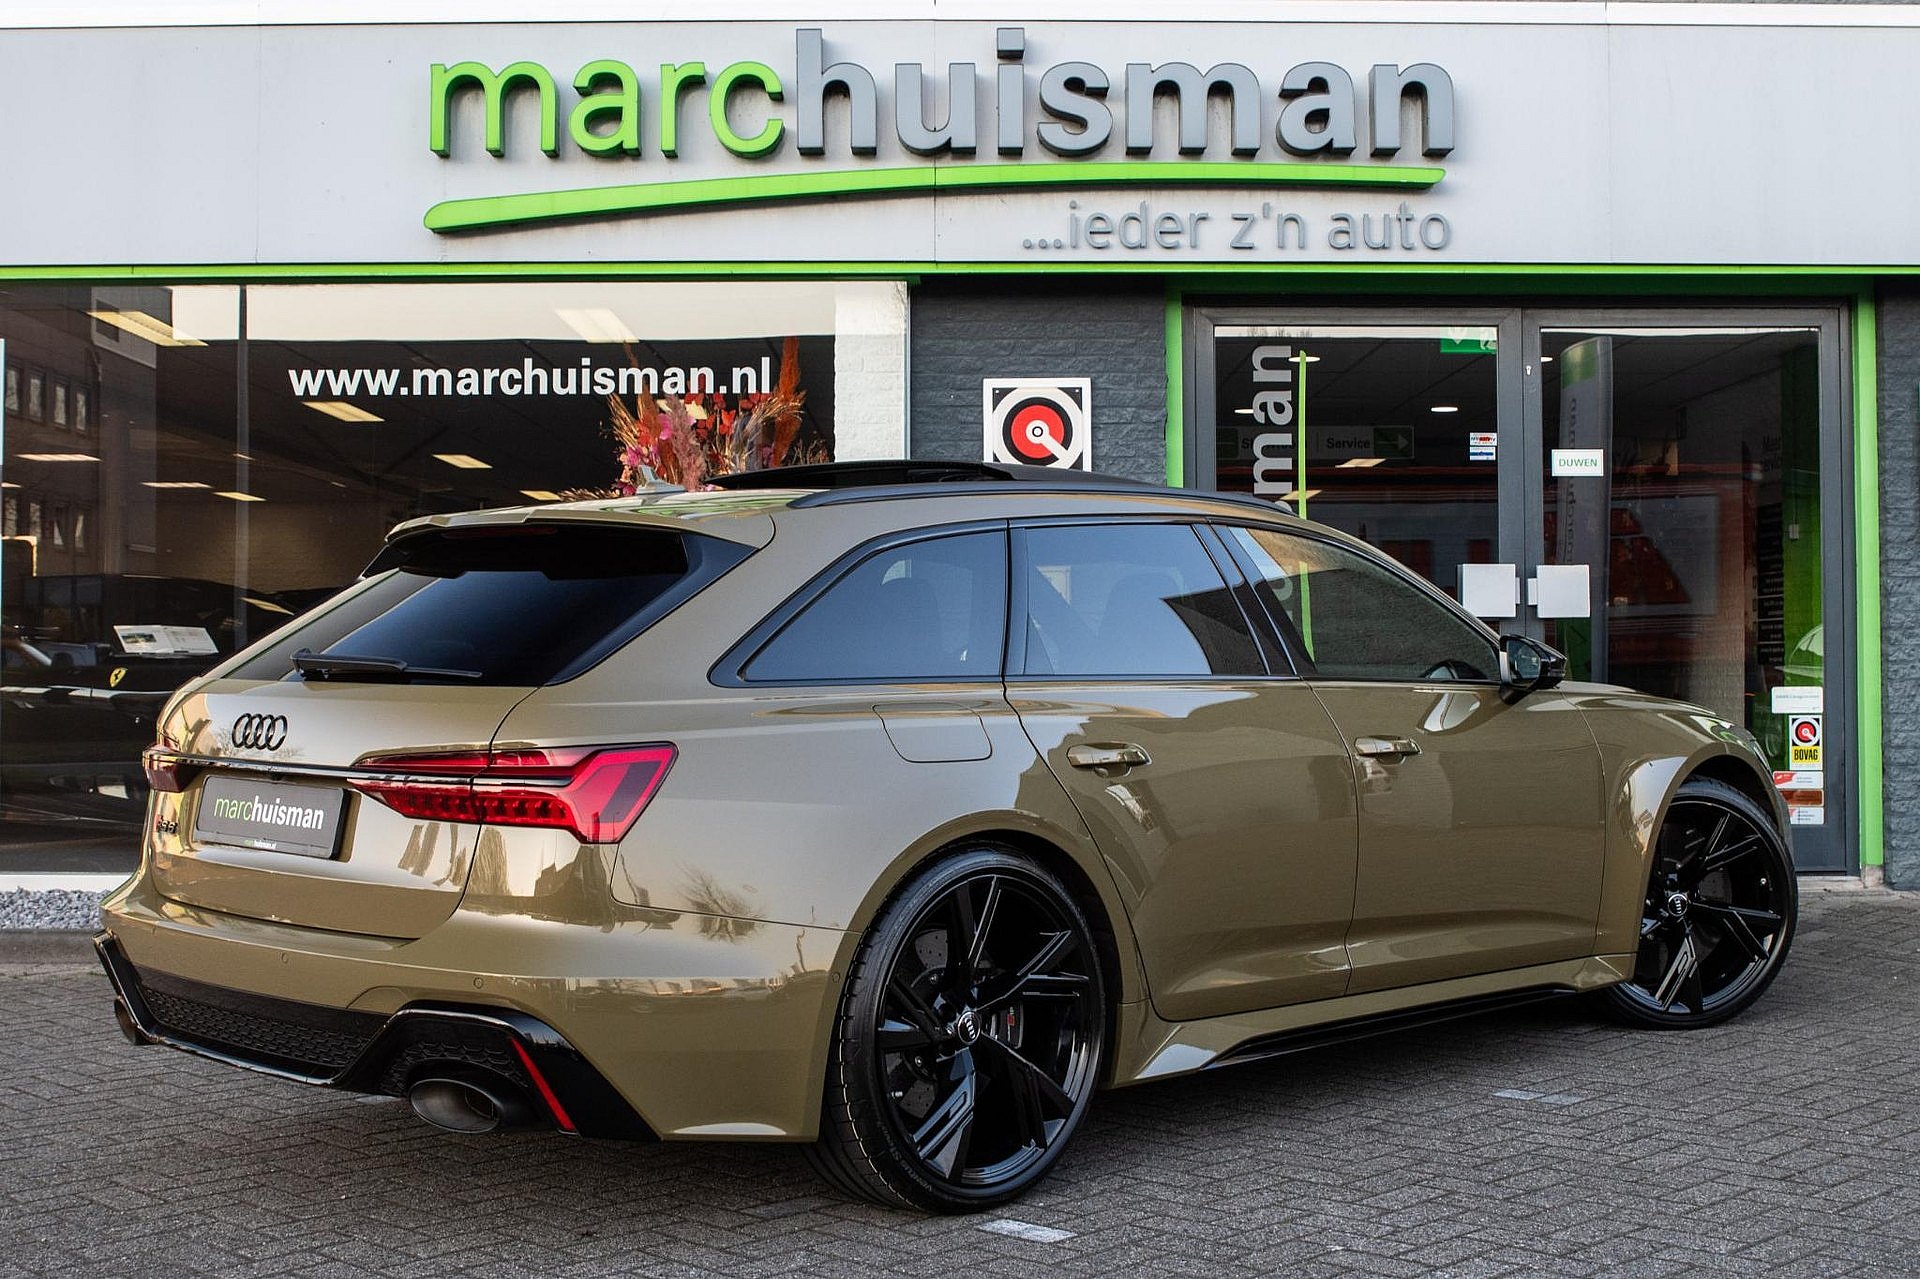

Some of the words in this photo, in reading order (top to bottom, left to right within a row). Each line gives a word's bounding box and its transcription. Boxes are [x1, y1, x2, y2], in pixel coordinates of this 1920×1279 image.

[430, 28, 1455, 158] marchuisman
[1230, 202, 1305, 249] z'n
[1328, 202, 1451, 250] auto
[289, 357, 771, 396] www.marchuisman.nl
[1326, 437, 1371, 450] Service
[1559, 458, 1597, 467] DUWEN
[1794, 748, 1818, 761] BOVAG
[213, 795, 324, 830] marchuisman
